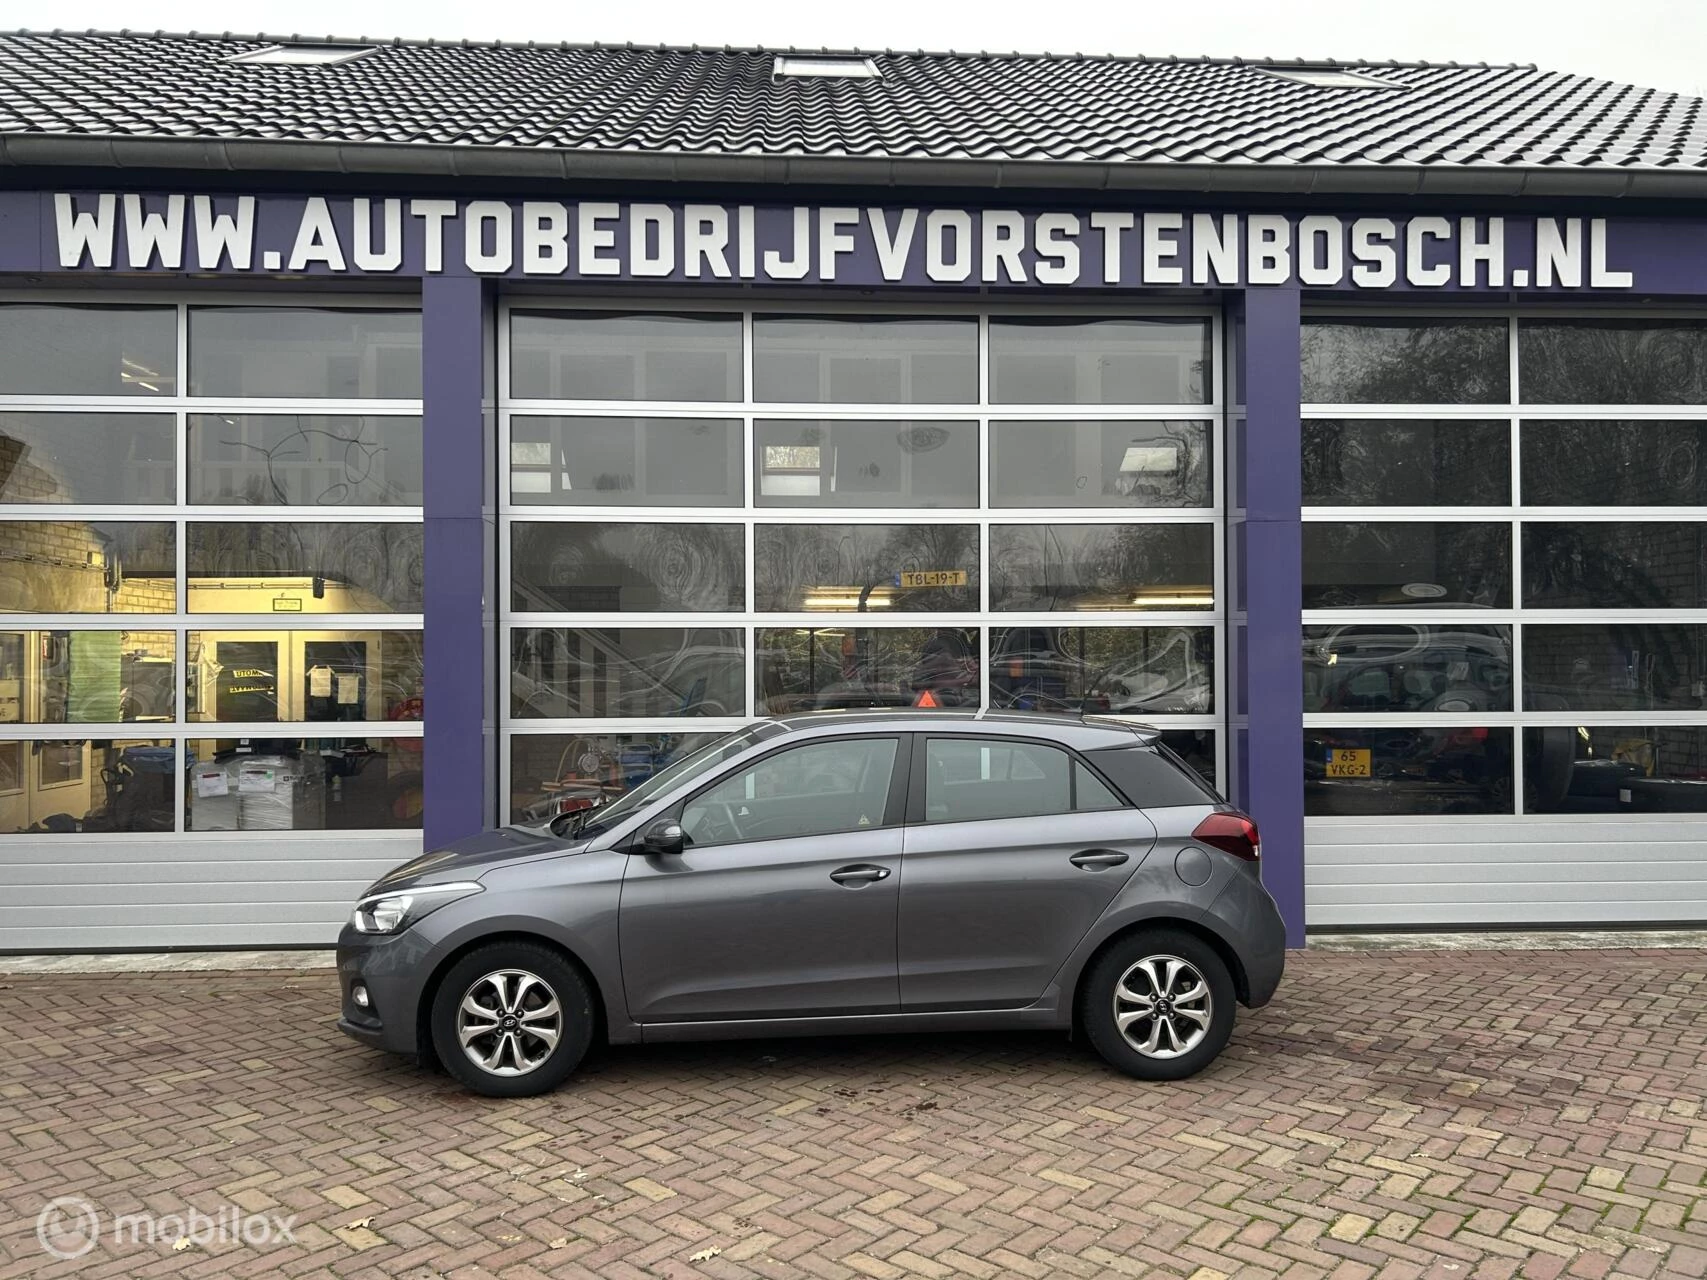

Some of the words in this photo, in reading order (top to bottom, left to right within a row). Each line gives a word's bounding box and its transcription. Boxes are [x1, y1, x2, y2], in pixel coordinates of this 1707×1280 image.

[54, 193, 1634, 289] WWW.AUTOBEDRIJFVORSTENBOSCH.NL
[907, 572, 960, 586] TBL-19-T
[1340, 750, 1357, 762] 65
[1330, 764, 1367, 776] VKG-2
